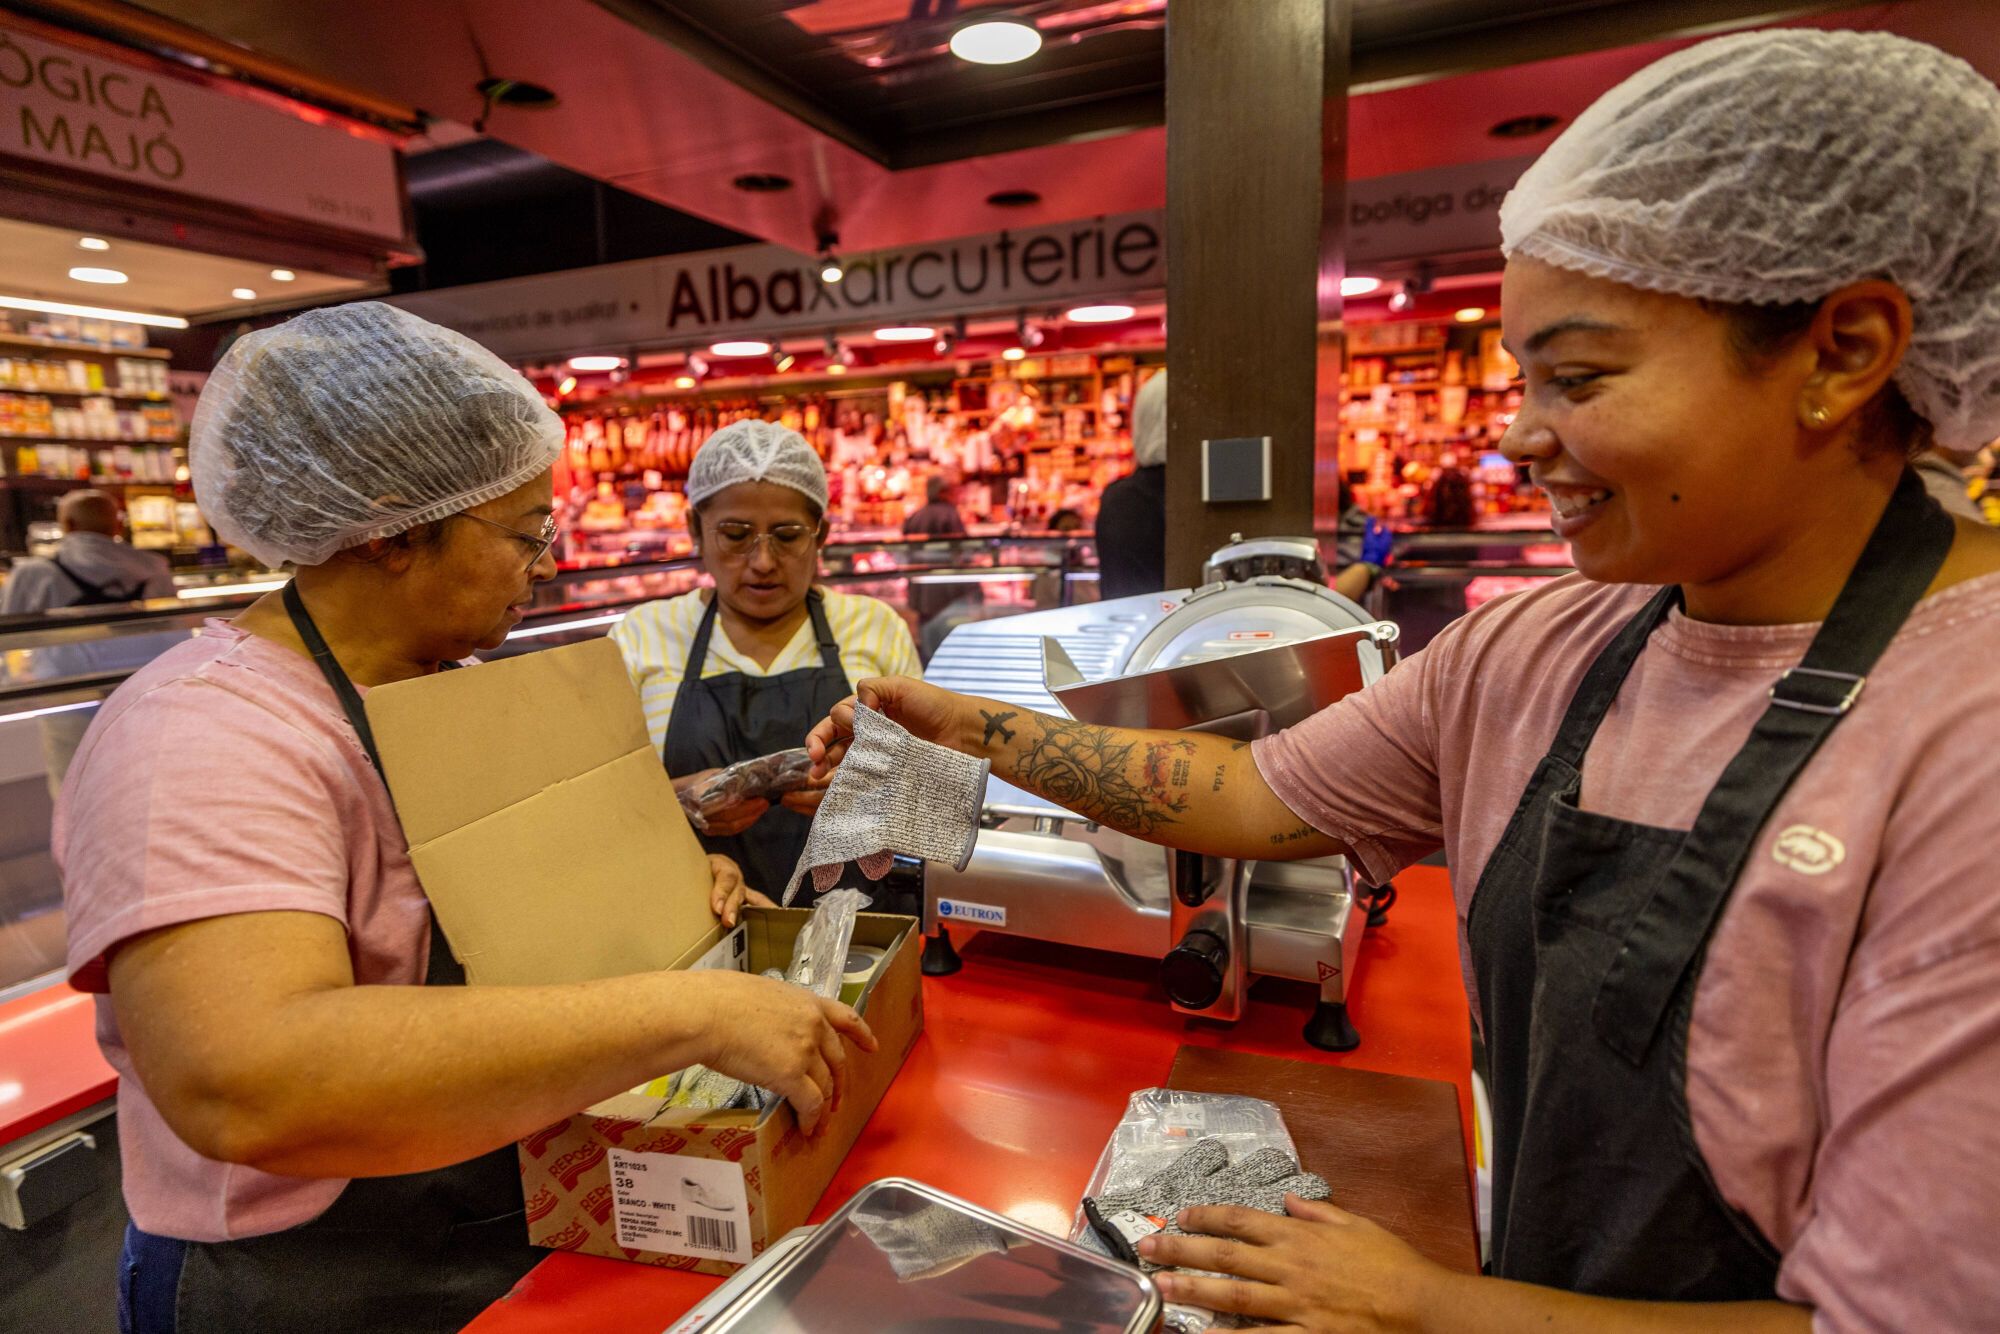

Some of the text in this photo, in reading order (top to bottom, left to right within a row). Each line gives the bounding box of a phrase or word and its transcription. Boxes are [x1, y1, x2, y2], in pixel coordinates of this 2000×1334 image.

[19, 105, 185, 181] MAJÓ
[667, 215, 1160, 329] Albaxarcuterie
[954, 905, 1003, 921] EUTRON
[548, 1140, 600, 1178] REPOSA
[616, 1177, 634, 1189] 38
[618, 1197, 647, 1208] BIANCO
[652, 1201, 676, 1211] WHITE
